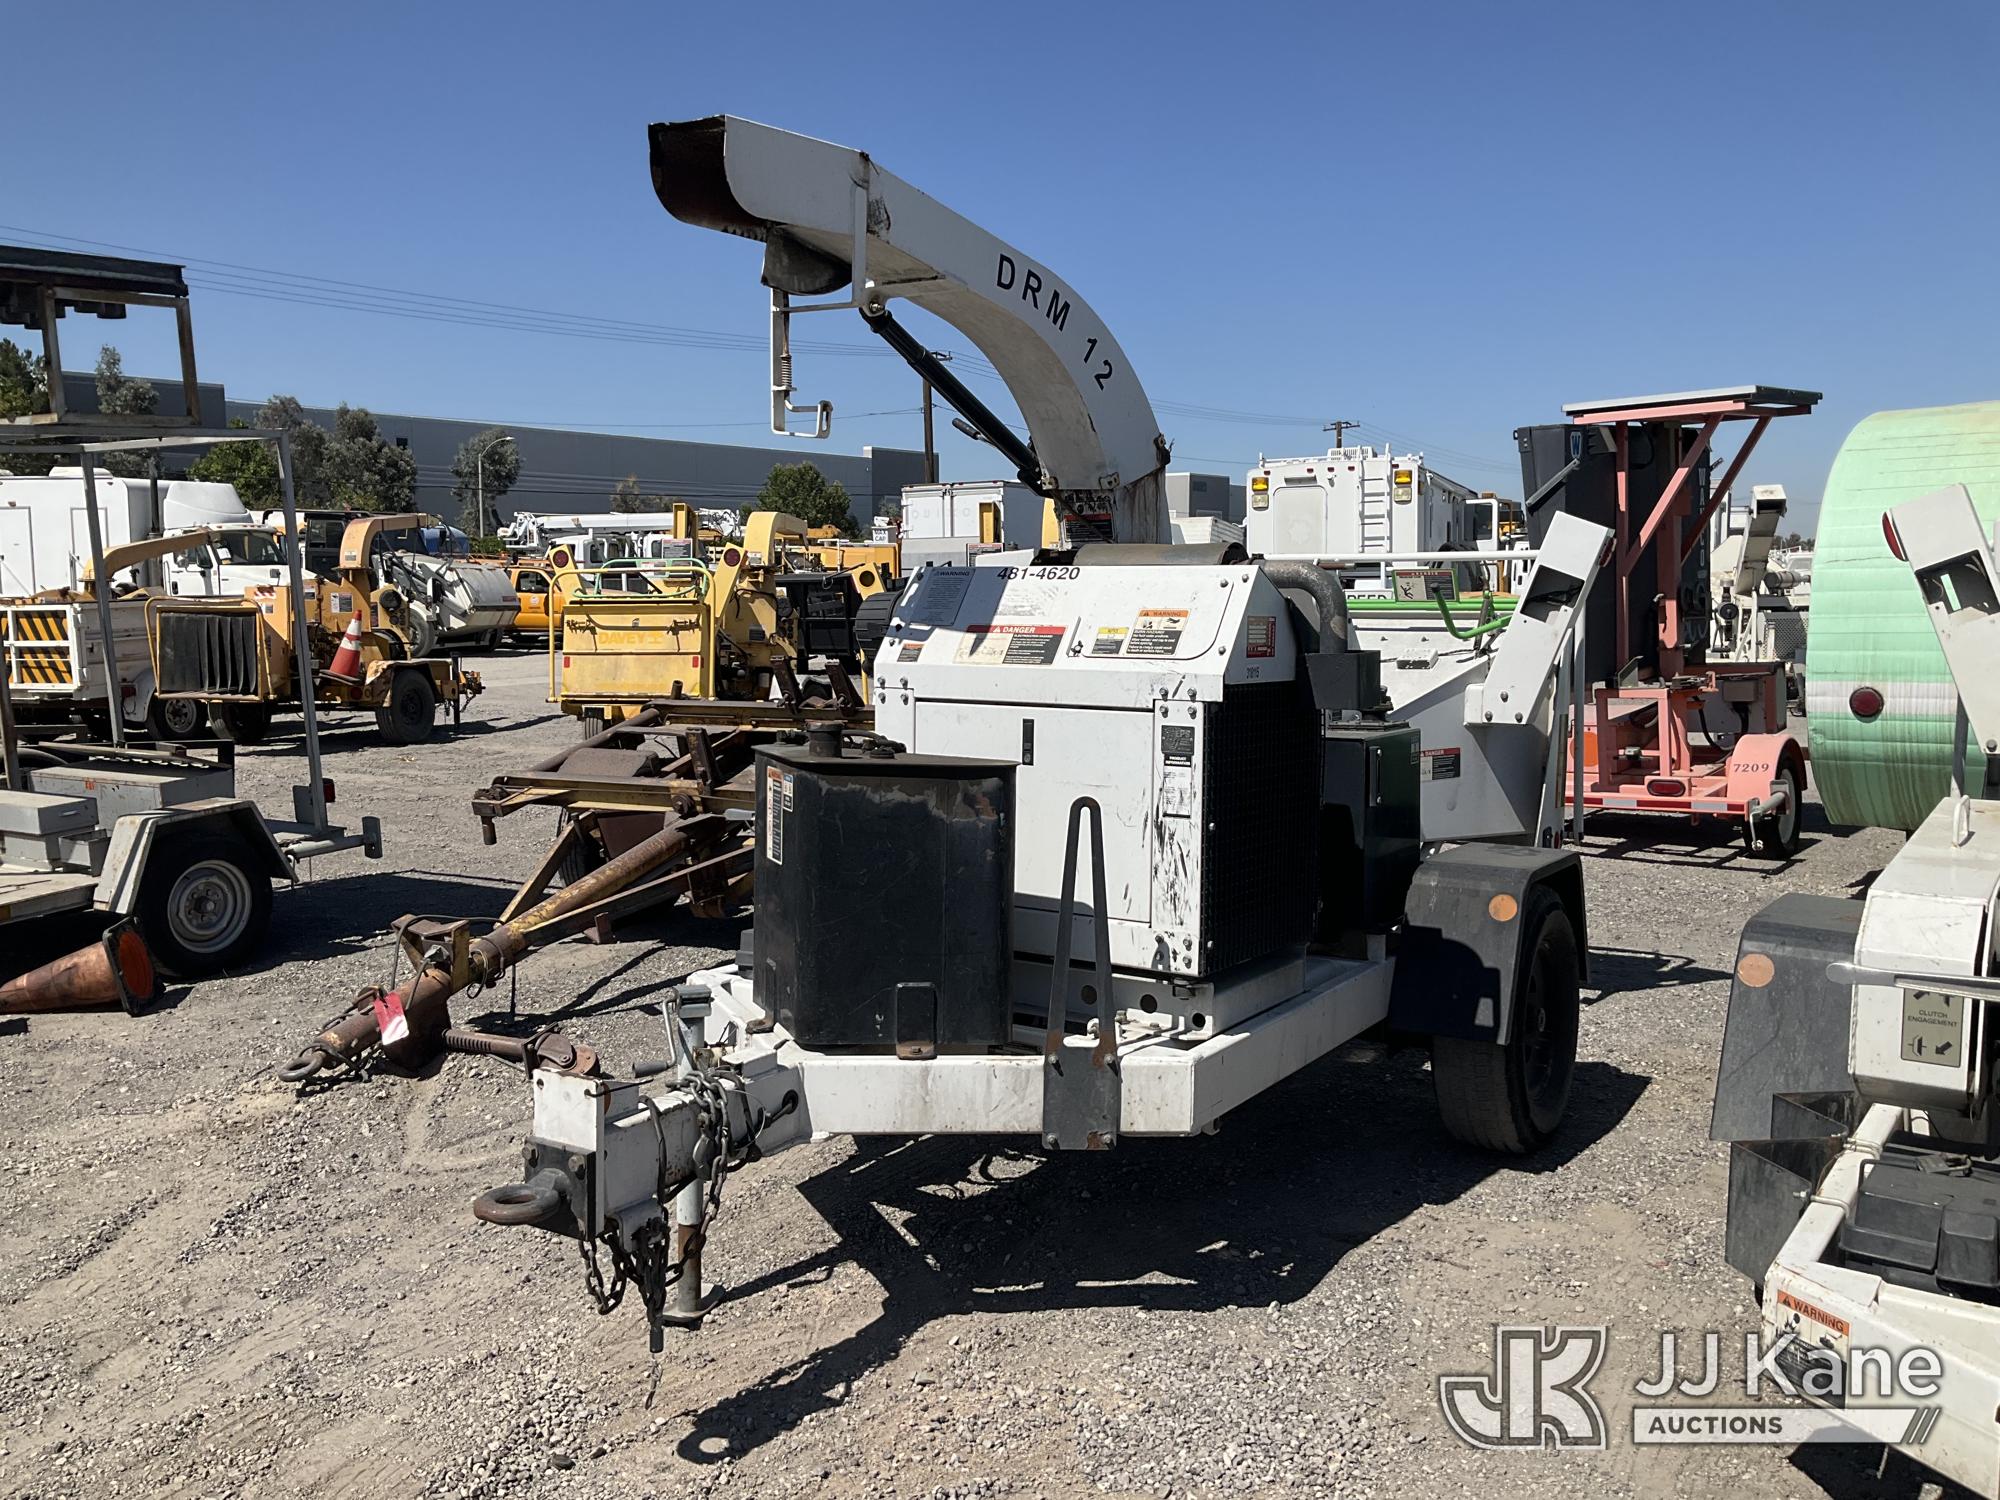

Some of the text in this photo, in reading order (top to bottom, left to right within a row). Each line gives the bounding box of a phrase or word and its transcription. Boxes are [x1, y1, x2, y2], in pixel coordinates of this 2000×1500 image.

[996, 253, 1113, 391] DRM 12
[997, 567, 1081, 580] 481-4620
[599, 632, 646, 645] DAVEY
[1733, 763, 1769, 773] 7209
[1919, 1009, 1948, 1019] CLUTCH
[1907, 1015, 1957, 1027] ENGAGEMENT
[1794, 1300, 1844, 1332] WARNING
